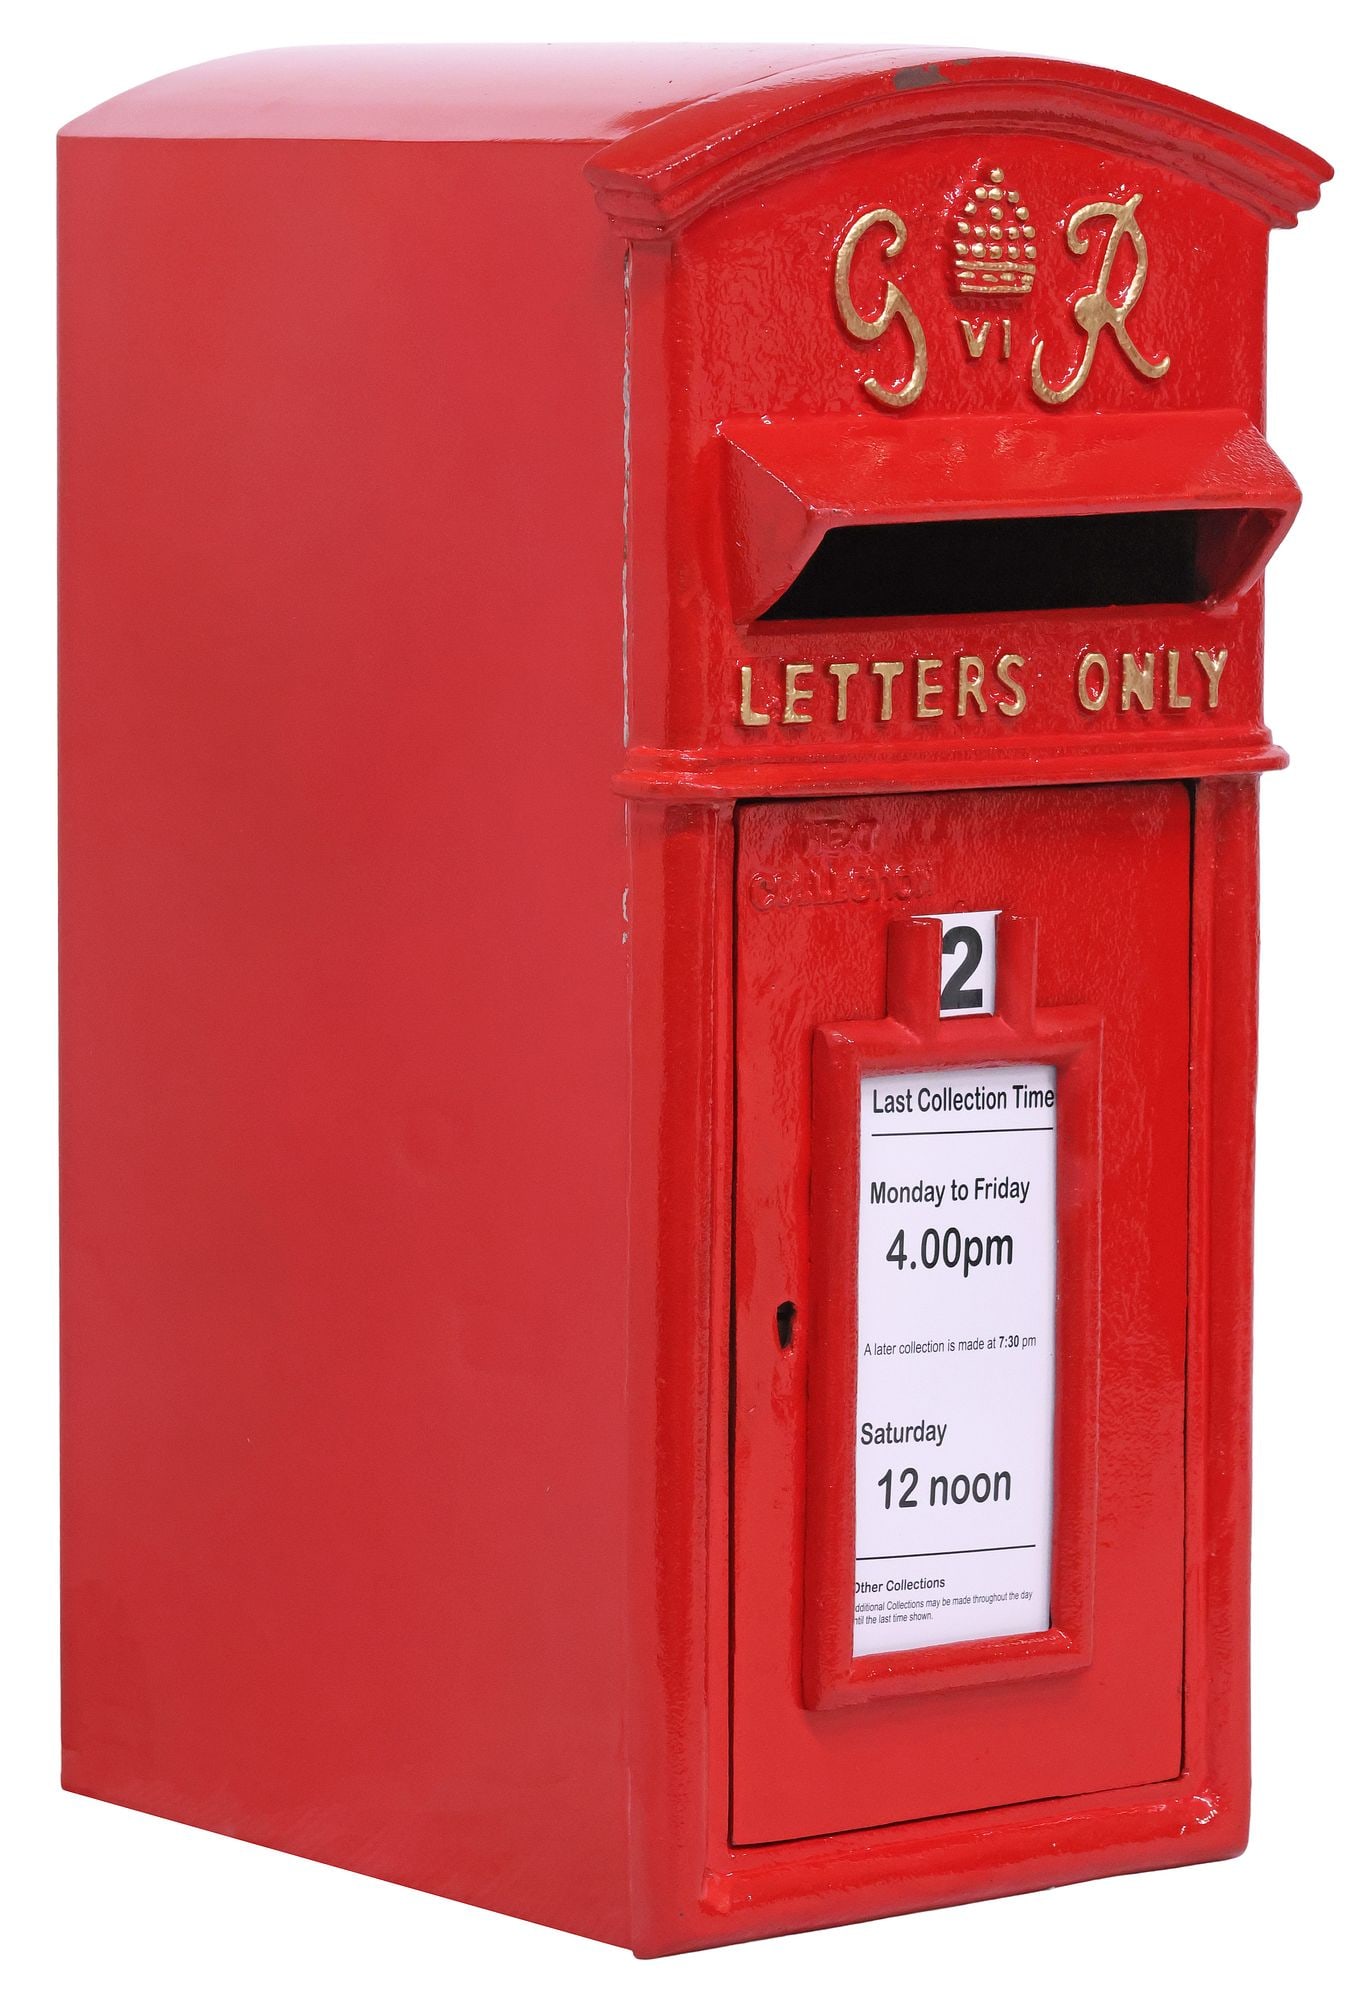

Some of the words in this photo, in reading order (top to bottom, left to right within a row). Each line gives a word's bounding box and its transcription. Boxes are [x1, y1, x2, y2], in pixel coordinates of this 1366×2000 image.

[836, 210, 926, 404] G
[1030, 194, 1170, 401] R
[960, 319, 1011, 359] VI
[741, 655, 1025, 724] LETTERS
[1080, 652, 1225, 710] ONLY
[940, 926, 982, 1010] 2
[874, 1089, 912, 1113] Last
[918, 1086, 1006, 1112] Collection
[871, 1180, 945, 1207] Monday
[951, 1180, 968, 1201] to
[975, 1177, 1029, 1203] Friday
[886, 1227, 1013, 1278] 4.00pm
[864, 1344, 871, 1355] A
[875, 1344, 896, 1355] later
[899, 1340, 944, 1354] collection
[948, 1339, 955, 1351] is
[959, 1338, 984, 1350] made
[987, 1338, 996, 1349] at
[999, 1335, 1019, 1348] 7:30
[1022, 1337, 1036, 1349] pm
[861, 1420, 946, 1446] Saturday
[878, 1468, 918, 1509] 12
[930, 1471, 1010, 1506] noon
[886, 1578, 945, 1591] Collections
[855, 1601, 885, 1612] dditional
[887, 1599, 924, 1610] Collections
[926, 1598, 940, 1609] may
[942, 1596, 950, 1607] be
[953, 1594, 971, 1605] made
[973, 1592, 1007, 1604] throughout
[1009, 1591, 1019, 1600] the
[1021, 1590, 1032, 1601] day
[866, 1614, 877, 1624] the
[879, 1613, 891, 1623] last
[893, 1612, 907, 1622] time
[910, 1611, 933, 1621] shown.
